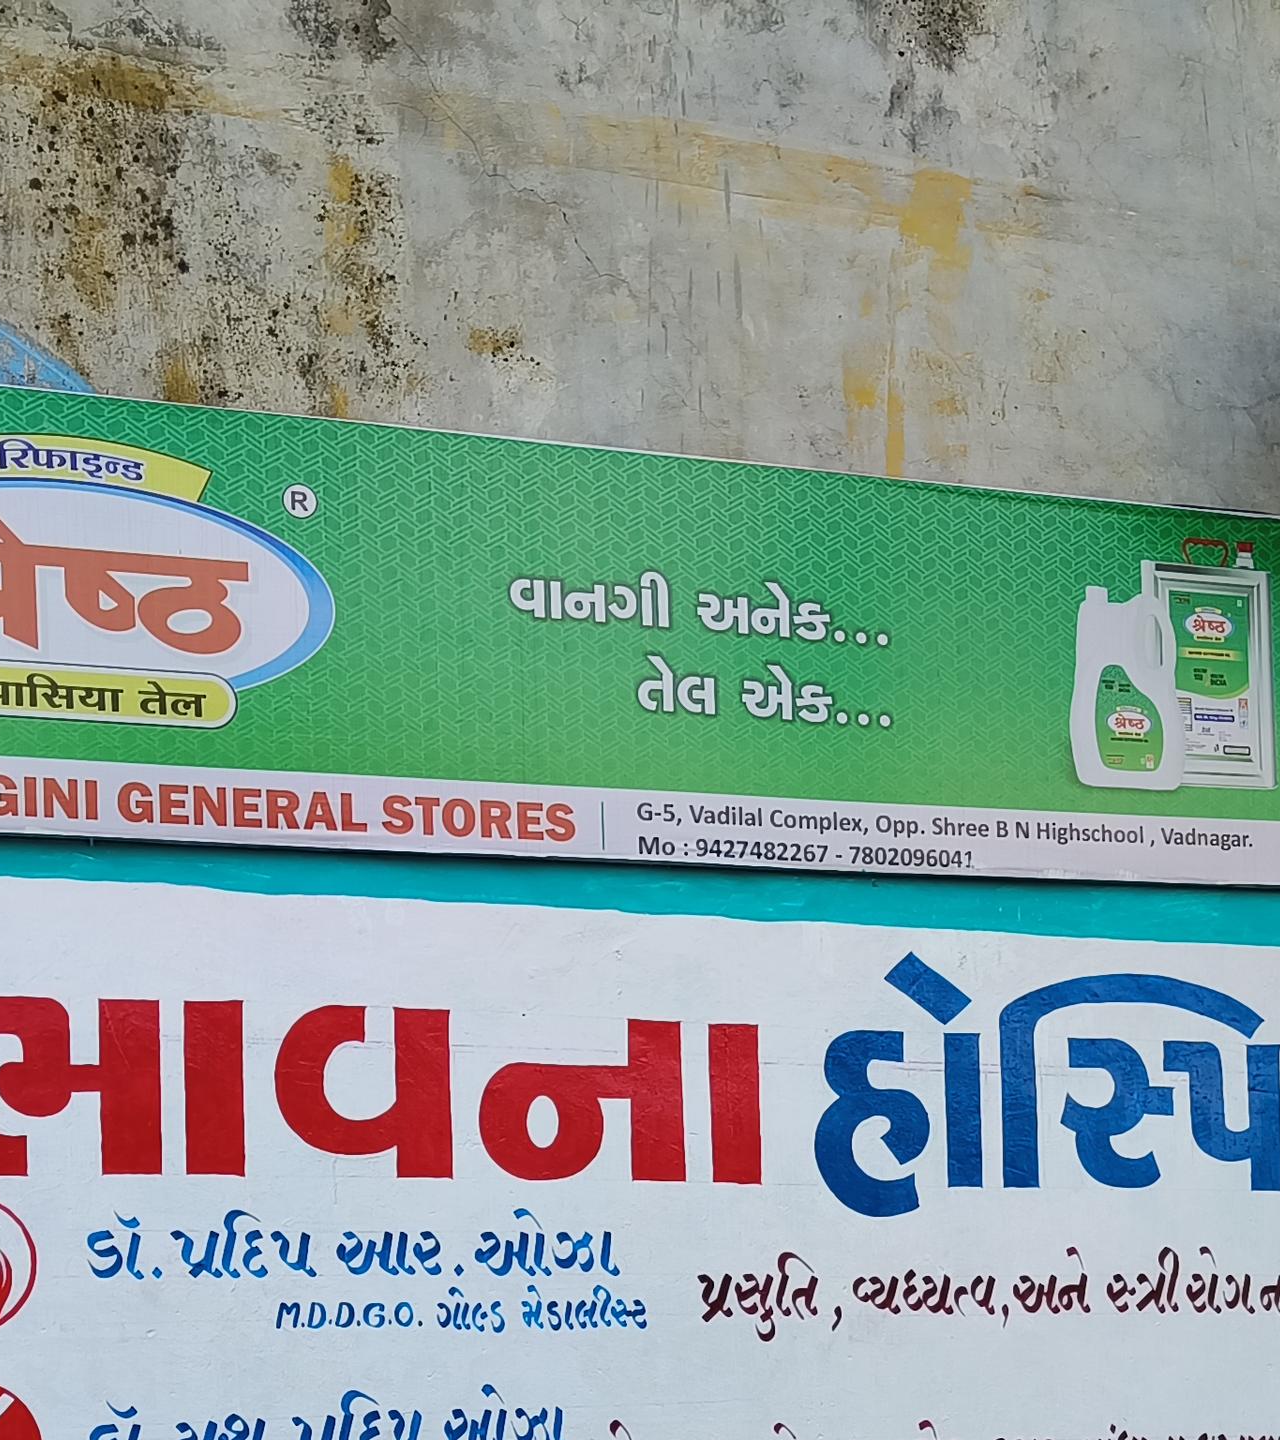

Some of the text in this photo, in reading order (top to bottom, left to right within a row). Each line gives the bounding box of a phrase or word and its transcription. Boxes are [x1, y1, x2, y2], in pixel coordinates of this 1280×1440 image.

[511, 572, 669, 627] વાનગી
[138, 680, 207, 719] तेल
[638, 656, 715, 714] તેલ
[118, 783, 367, 832] GENERAL
[383, 795, 575, 841] STORES
[637, 803, 681, 826] G-5,
[689, 805, 762, 826] Vadilal
[770, 810, 868, 835] Complex,
[876, 816, 924, 838] Opp.
[932, 817, 989, 837] Shree
[997, 821, 1008, 837] B
[1016, 822, 1029, 838] N
[1037, 822, 1143, 845] Highschool
[1161, 828, 1252, 850] Vadnagar.
[639, 836, 675, 855] Mo
[695, 838, 828, 863] 9427482267
[849, 847, 971, 868] 7802096041
[475, 1209, 620, 1276] ઓઝા
